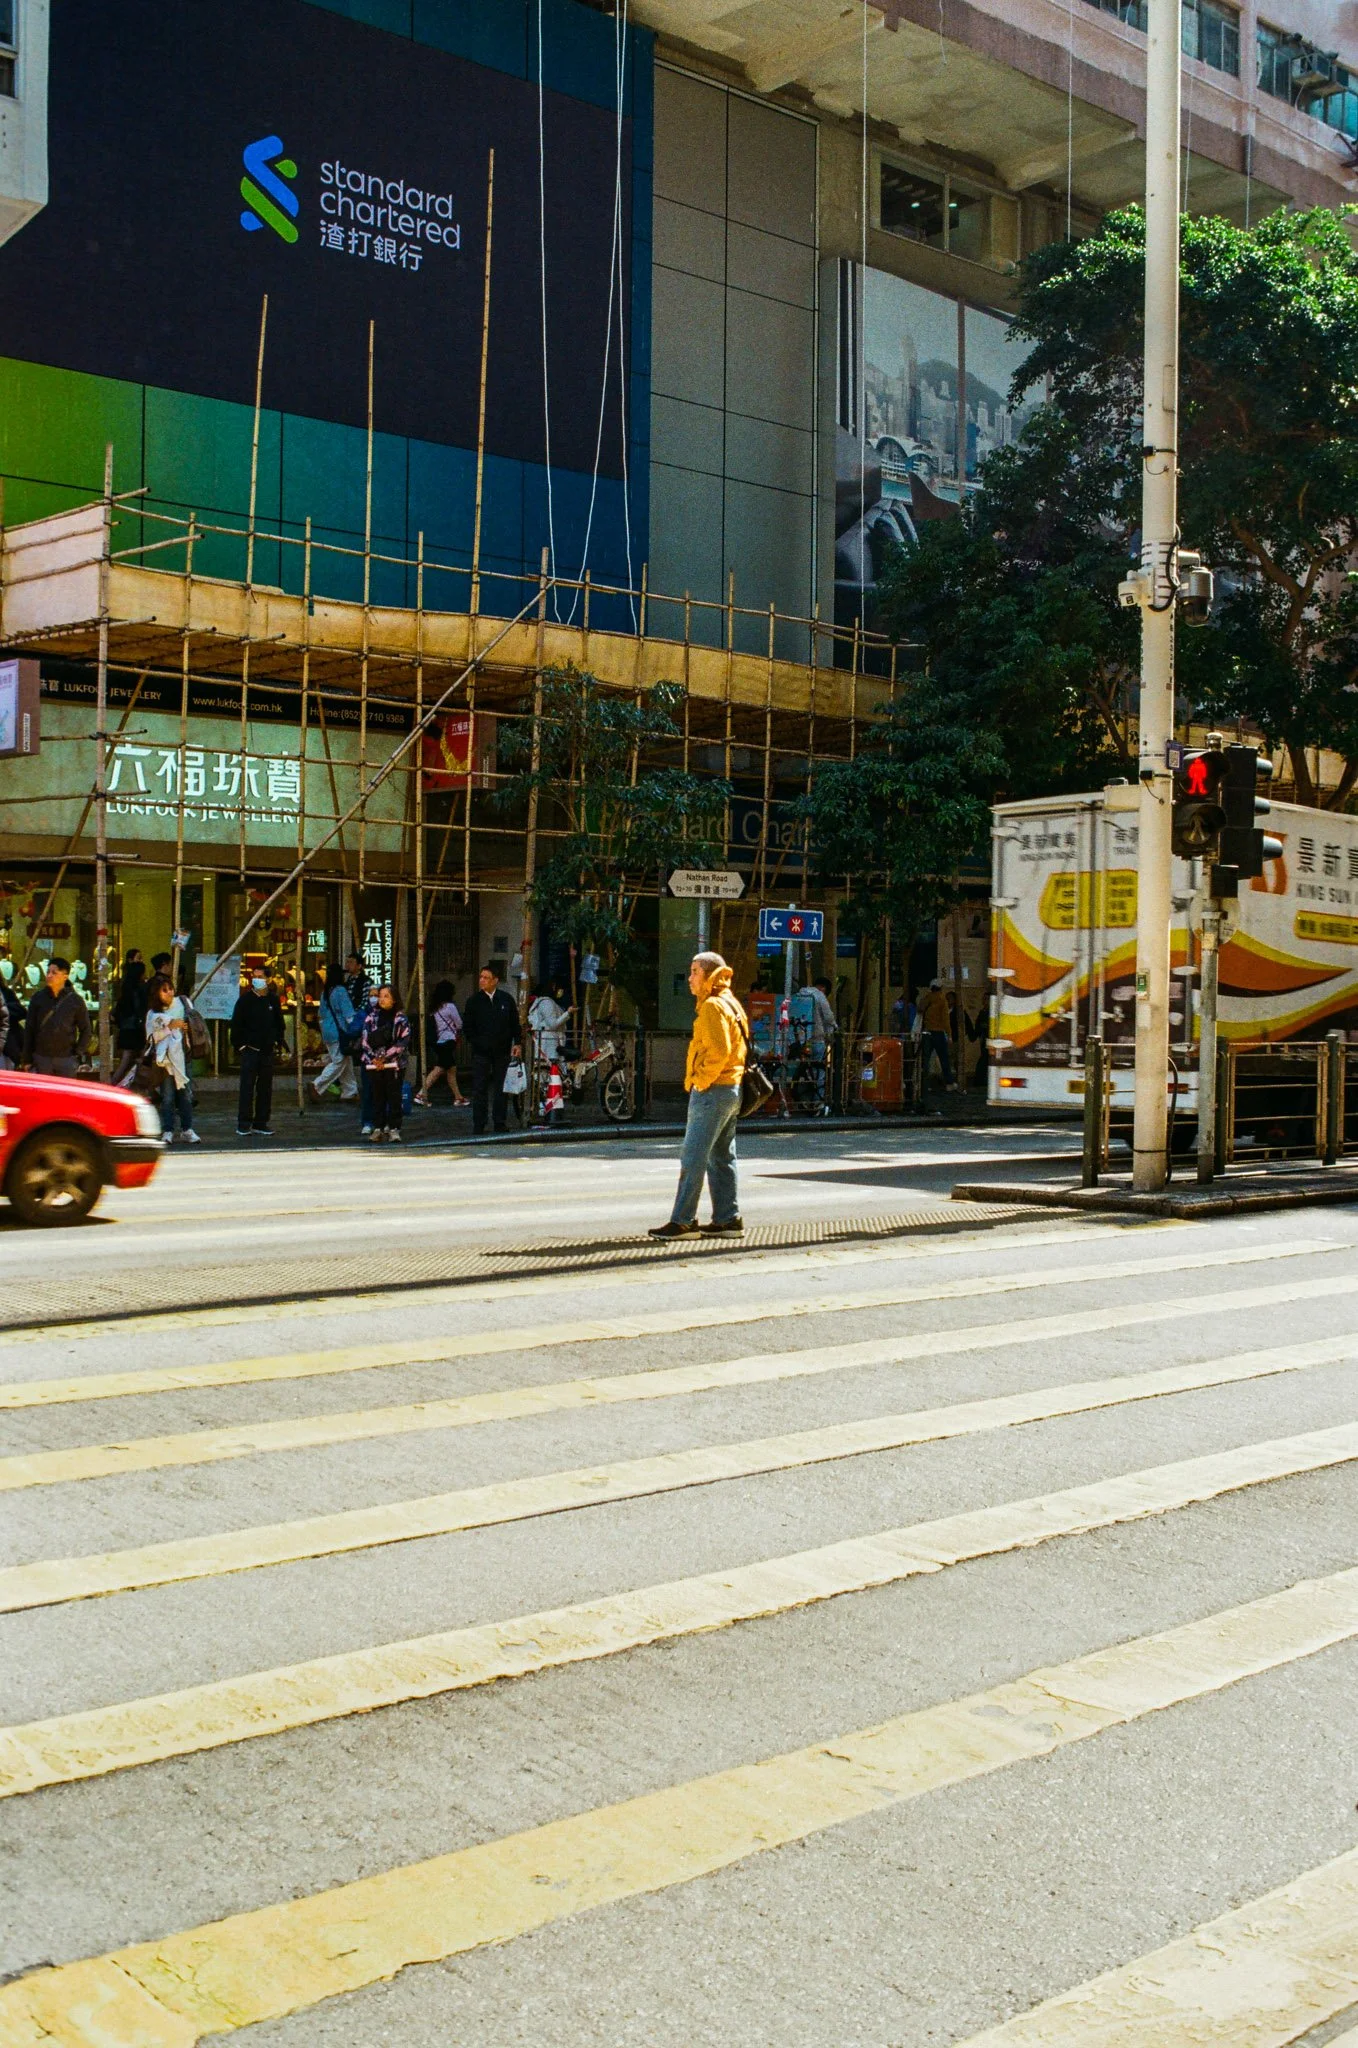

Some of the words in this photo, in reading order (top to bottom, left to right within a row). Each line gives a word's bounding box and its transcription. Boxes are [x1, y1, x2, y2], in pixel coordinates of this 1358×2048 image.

[320, 160, 453, 219] standard
[320, 189, 460, 250] chartered
[320, 219, 423, 272] 渣打銀行
[64, 683, 108, 695] LUKFO
[110, 687, 162, 700] JEWELERY
[192, 697, 283, 713] www.lukfoo.com.hk
[106, 737, 300, 804] 六福珠寶
[712, 874, 728, 882] Road
[307, 929, 325, 946] 六福
[384, 919, 392, 961] LUKFOOK
